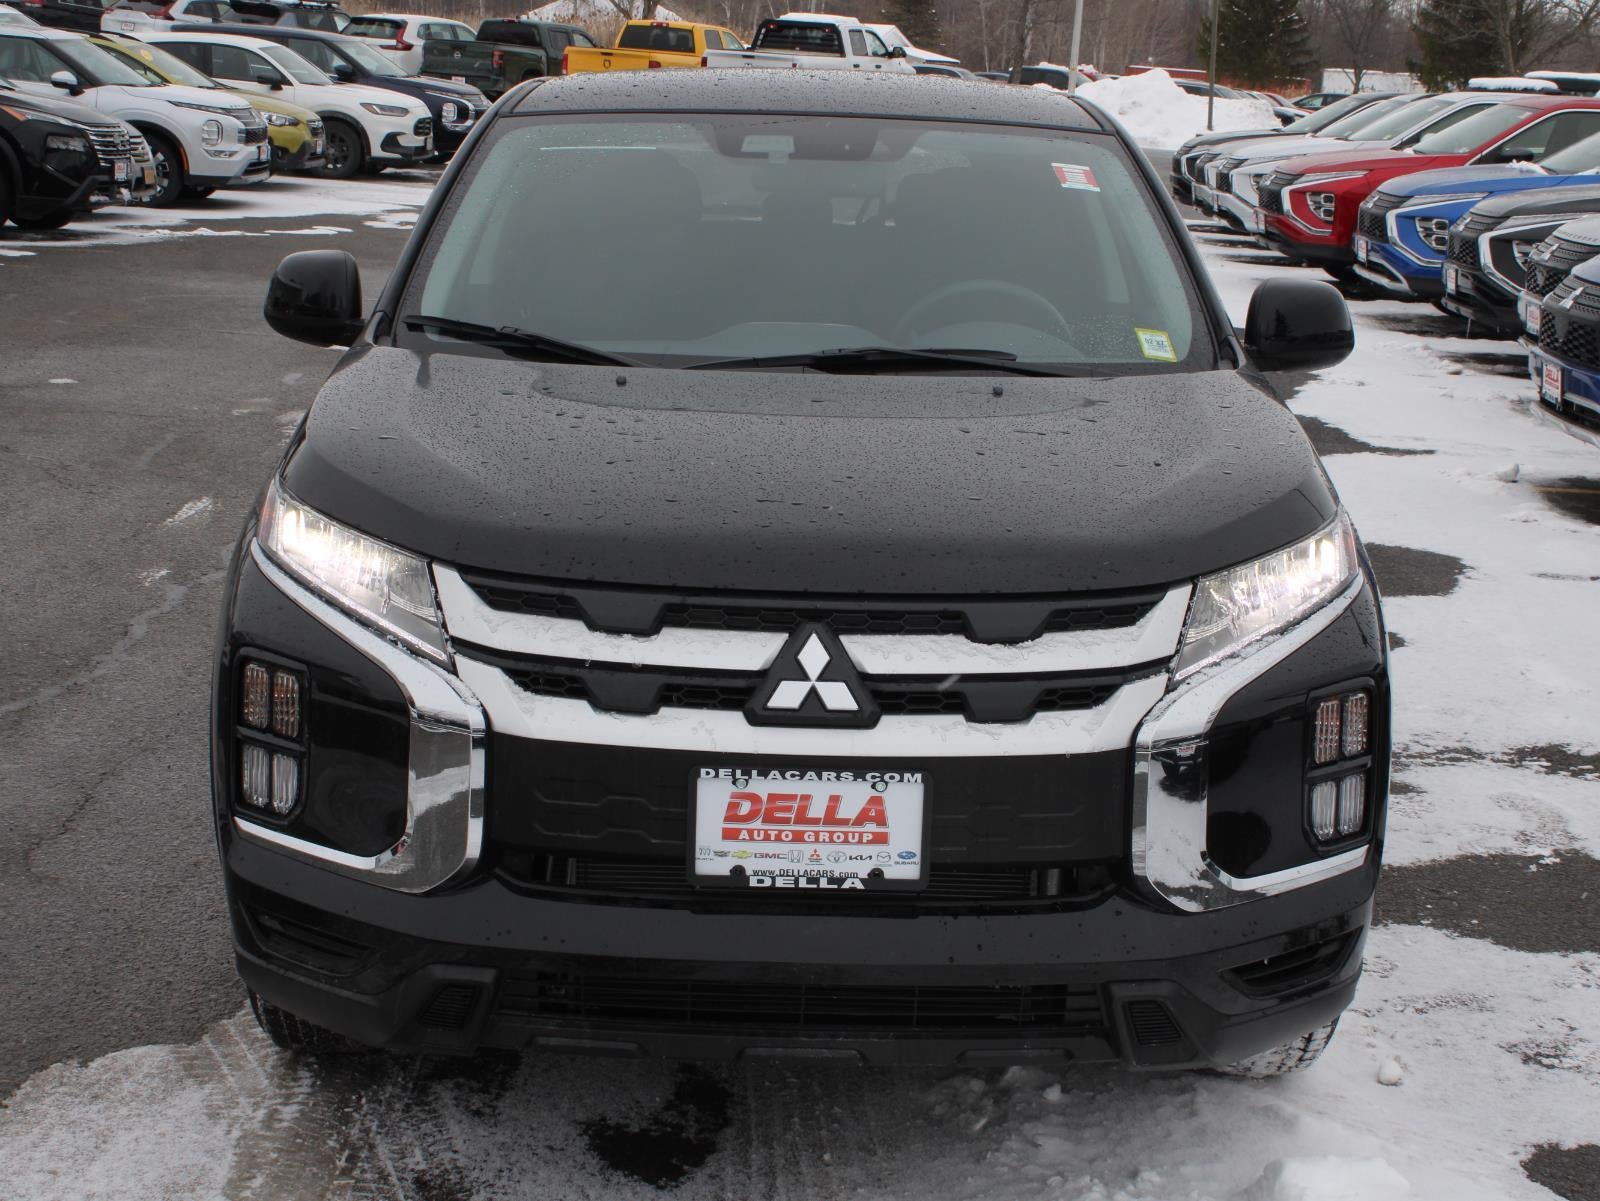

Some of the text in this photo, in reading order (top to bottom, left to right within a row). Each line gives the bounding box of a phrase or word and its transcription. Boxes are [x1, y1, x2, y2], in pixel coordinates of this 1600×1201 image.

[700, 768, 922, 783] DELLACARS.COM
[722, 791, 889, 828] DELLA
[738, 830, 873, 843] AUTO GROUP
[754, 852, 788, 860] GMC
[752, 868, 859, 878] www.DELLACARS.com
[749, 875, 865, 889] DELLA
